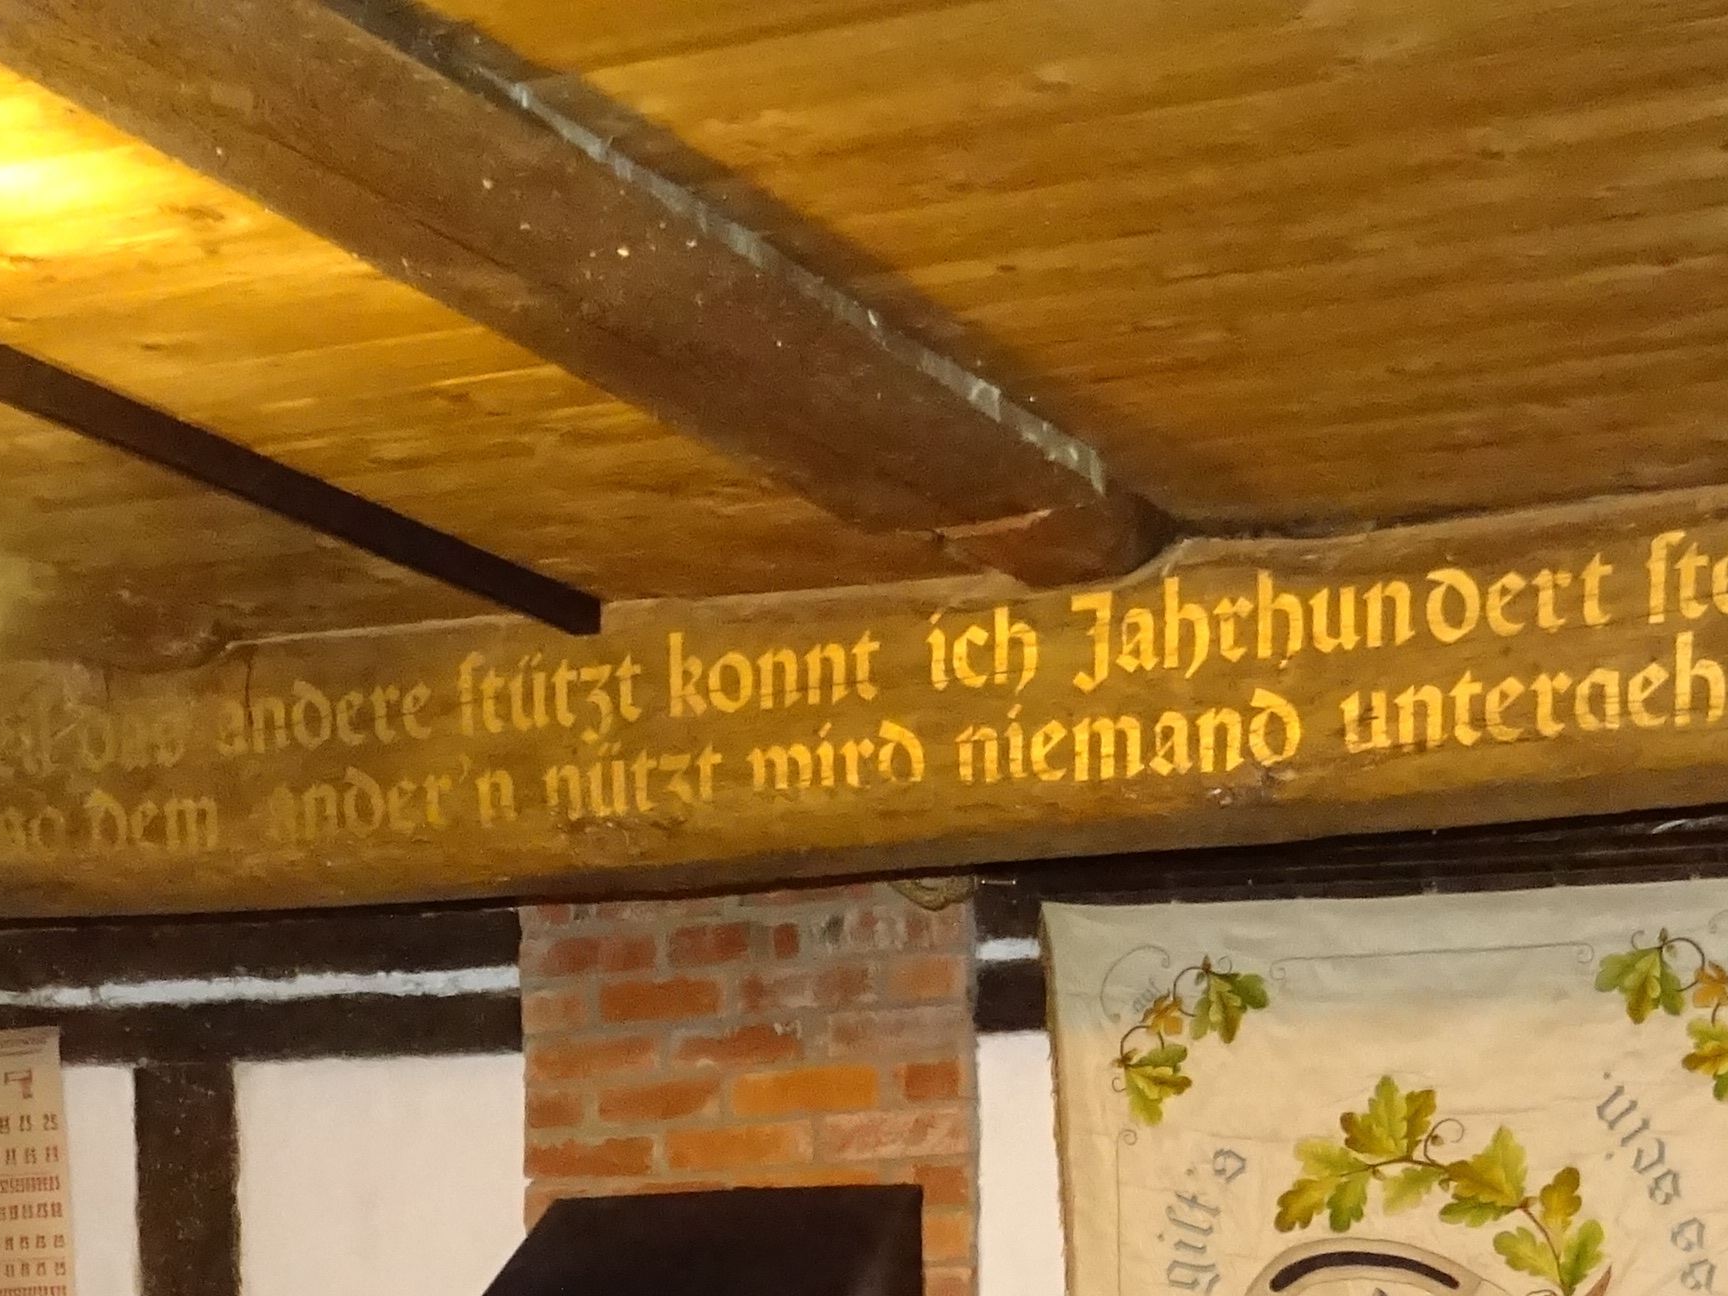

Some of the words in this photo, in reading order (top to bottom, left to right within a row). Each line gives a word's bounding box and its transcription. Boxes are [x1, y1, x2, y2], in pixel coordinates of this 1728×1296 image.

[217, 680, 432, 756] andere
[669, 631, 880, 718] konnt
[927, 606, 1039, 694] ich
[1073, 552, 1613, 694] Jahrhundert
[83, 789, 220, 850] dem
[544, 741, 722, 822] nützt
[747, 720, 926, 792] wird
[955, 688, 1302, 784] niemand
